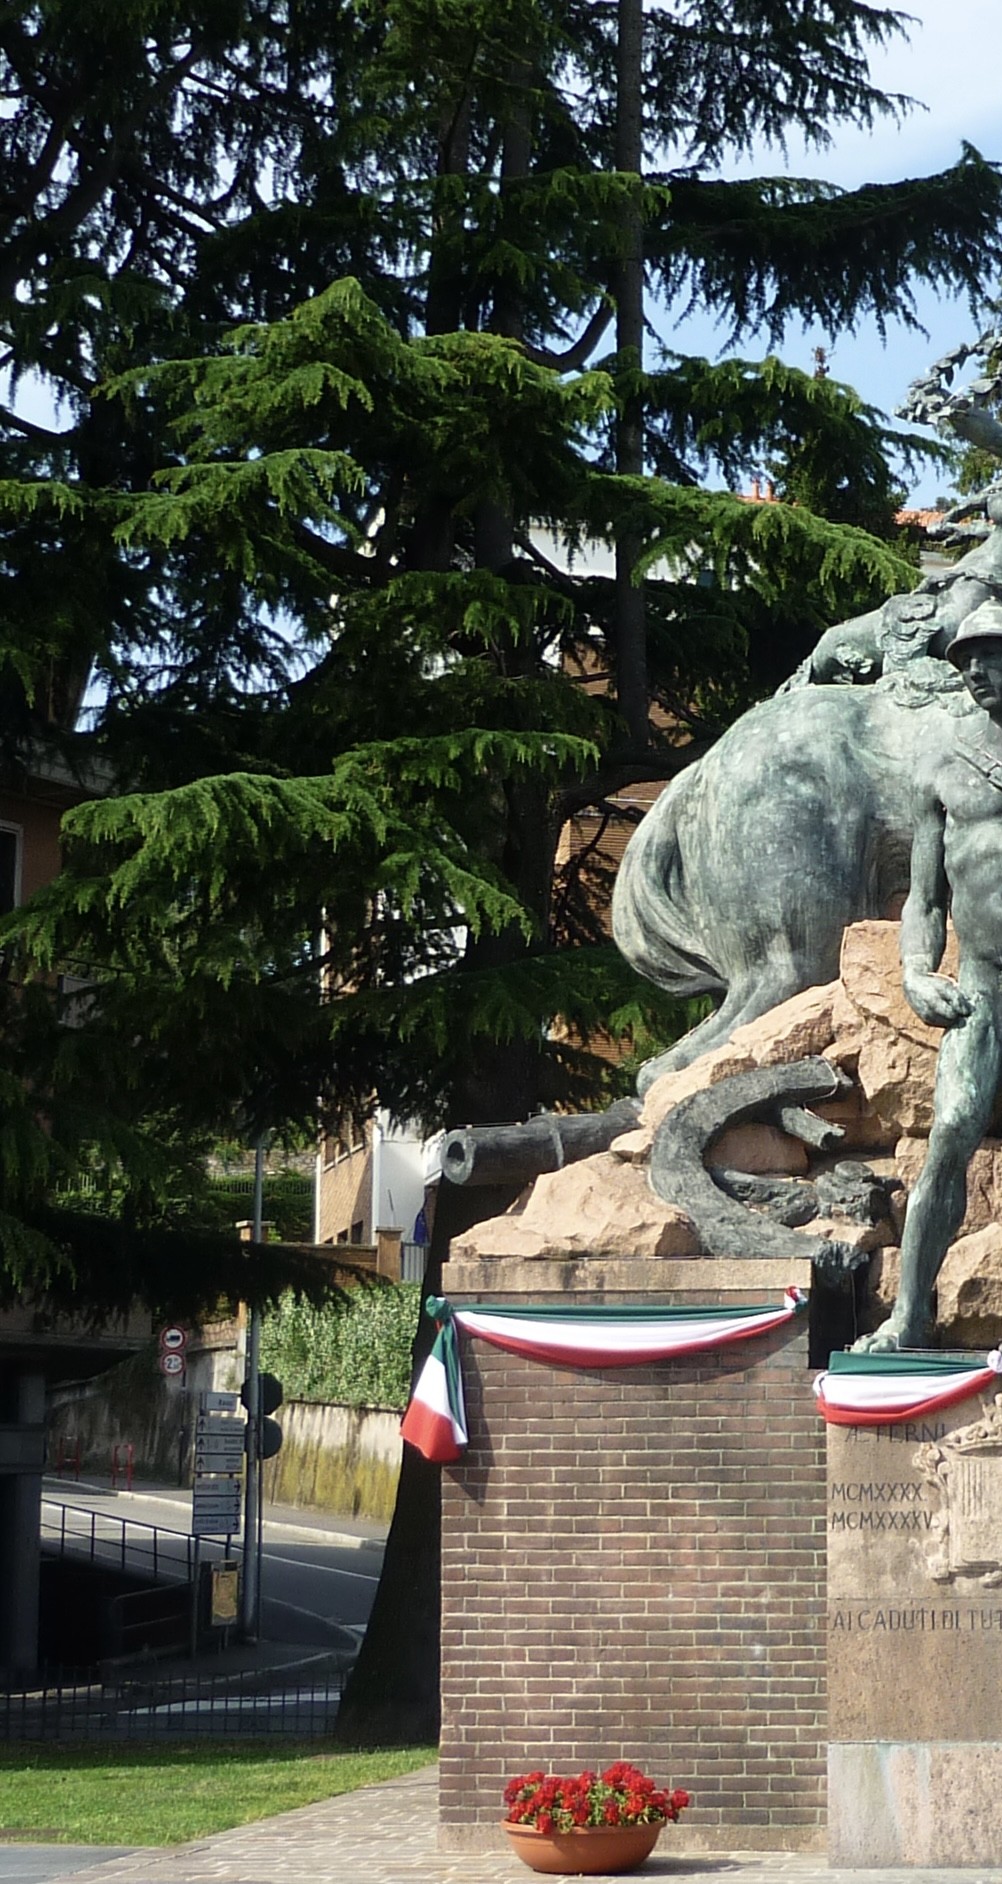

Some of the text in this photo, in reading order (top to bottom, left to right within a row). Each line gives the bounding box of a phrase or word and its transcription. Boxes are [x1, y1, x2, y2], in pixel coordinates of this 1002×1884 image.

[831, 1511, 933, 1530] MCMXXXXV
[833, 1610, 852, 1631] AI
[858, 1608, 936, 1631] CADUTI
